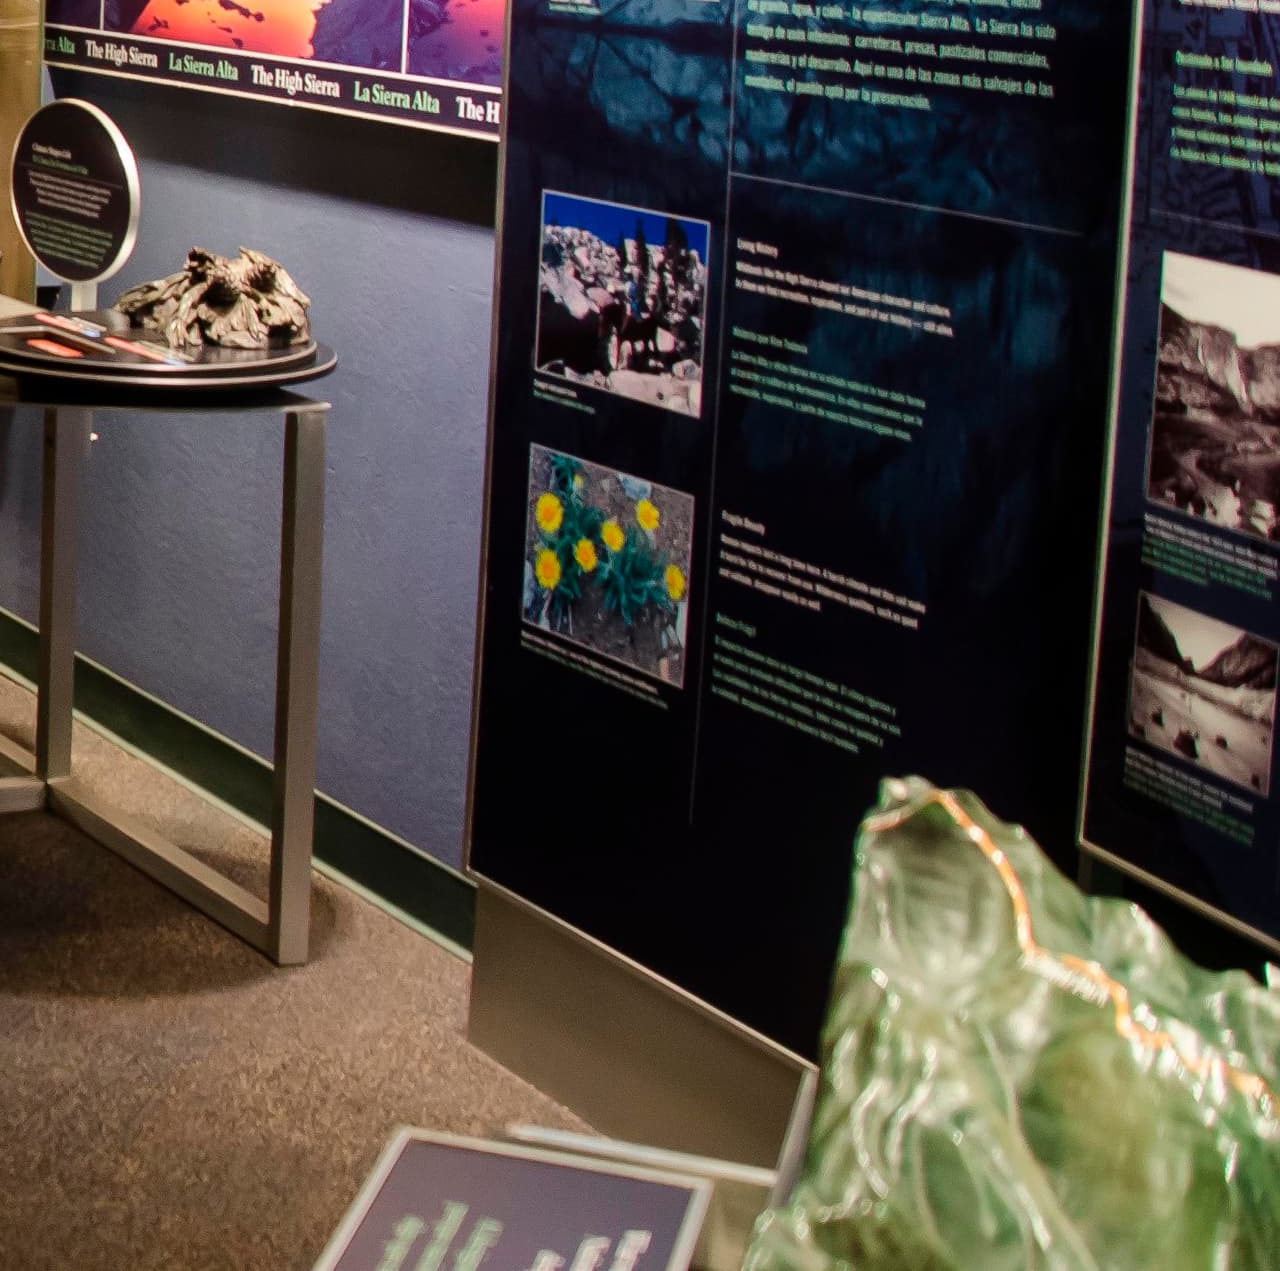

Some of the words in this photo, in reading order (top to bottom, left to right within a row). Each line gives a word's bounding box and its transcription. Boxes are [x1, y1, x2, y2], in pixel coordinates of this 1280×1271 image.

[976, 17, 987, 33] La
[989, 19, 1018, 36] Sierra
[59, 36, 75, 54] Alta
[86, 39, 104, 59] The
[105, 42, 128, 67] High
[129, 46, 158, 68] Sierra
[169, 53, 182, 72] La
[183, 56, 214, 77] Sierra
[216, 60, 239, 80] Alta
[251, 64, 273, 87] The
[275, 68, 303, 95] High
[305, 72, 340, 98] Sierra
[354, 81, 370, 102] La
[372, 84, 410, 109] Sierra
[412, 90, 440, 113] Alta
[456, 96, 484, 121] The
[1024, 80, 1037, 95] de
